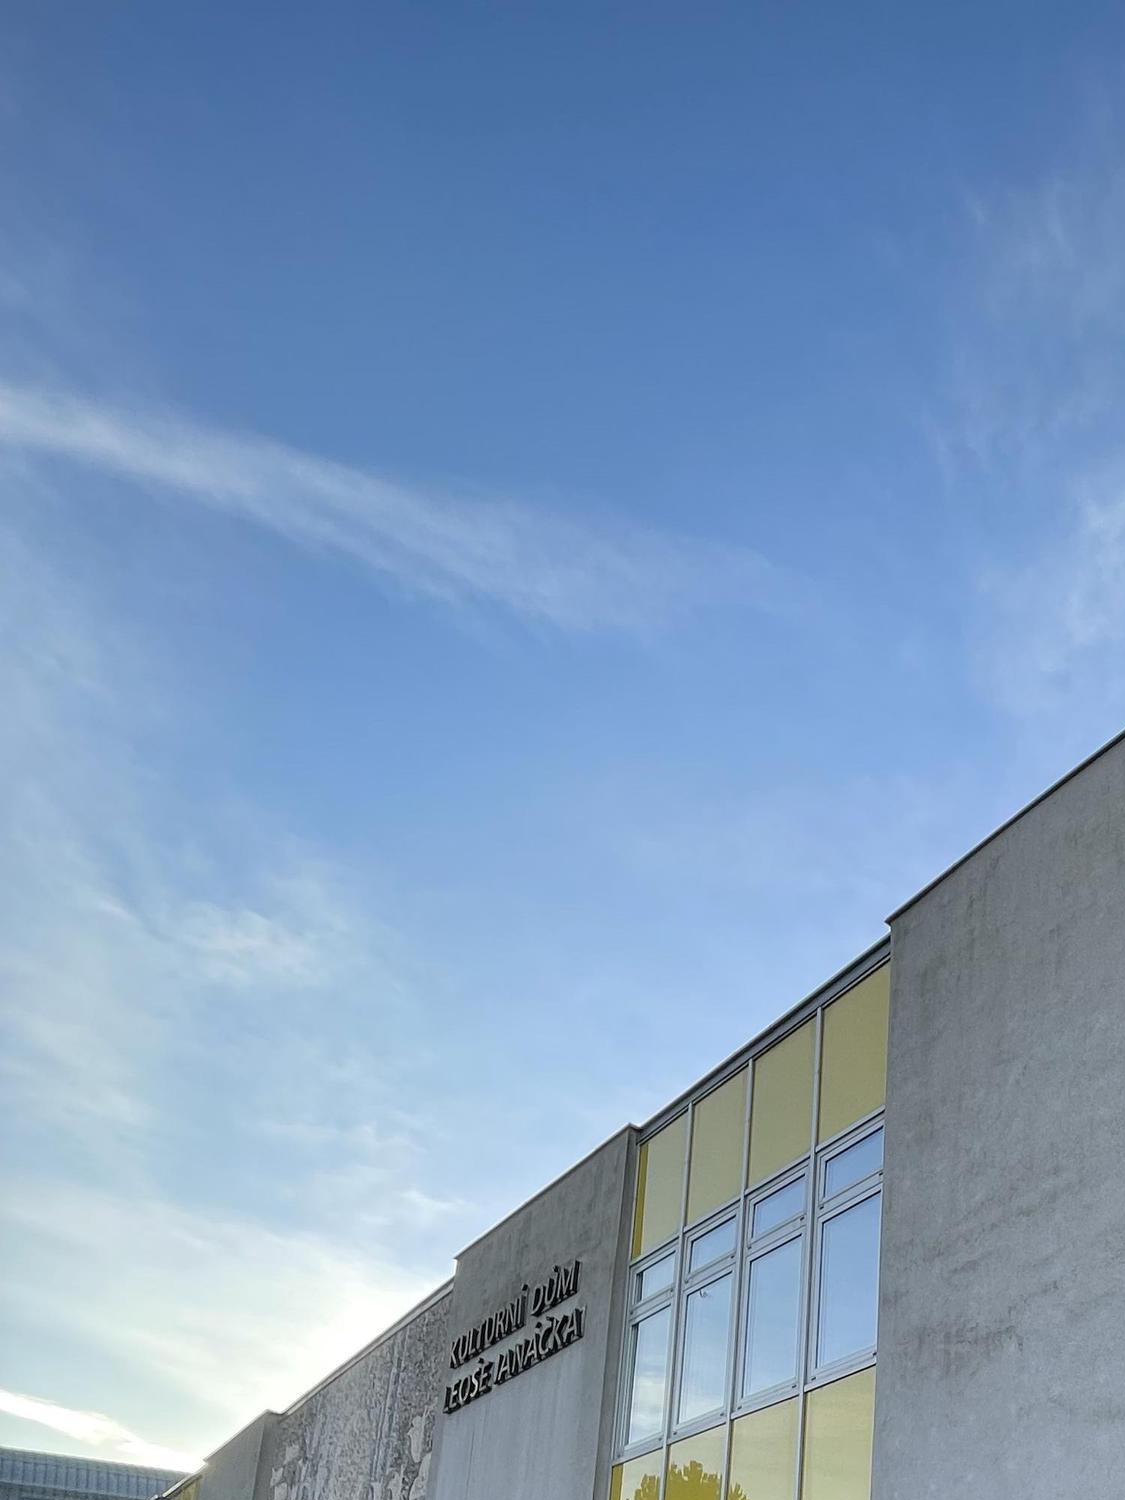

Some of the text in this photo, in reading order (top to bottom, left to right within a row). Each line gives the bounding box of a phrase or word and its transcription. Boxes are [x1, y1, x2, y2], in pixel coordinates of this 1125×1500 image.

[450, 1260, 582, 1369] KULTURNÍ DŮM
[443, 1358, 493, 1414] LEOŠE
